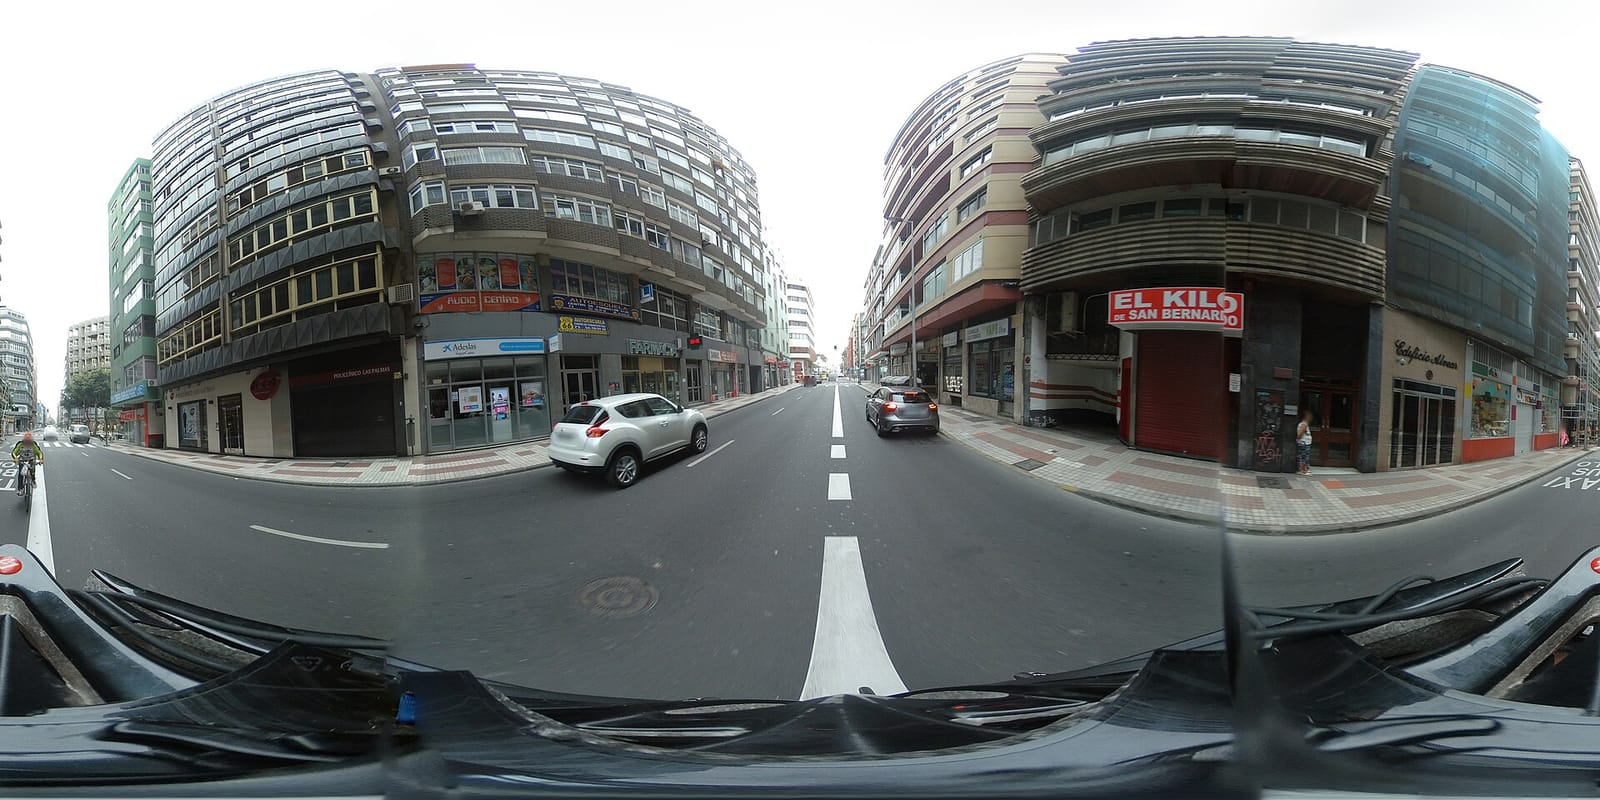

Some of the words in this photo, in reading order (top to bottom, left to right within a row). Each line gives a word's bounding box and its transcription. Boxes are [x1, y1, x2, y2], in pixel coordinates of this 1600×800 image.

[1114, 292, 1152, 309] EL
[1163, 290, 1238, 313] KILO
[1128, 309, 1158, 320] SAN
[1161, 308, 1238, 326] BERNARDO
[1541, 476, 1600, 491] AXI
